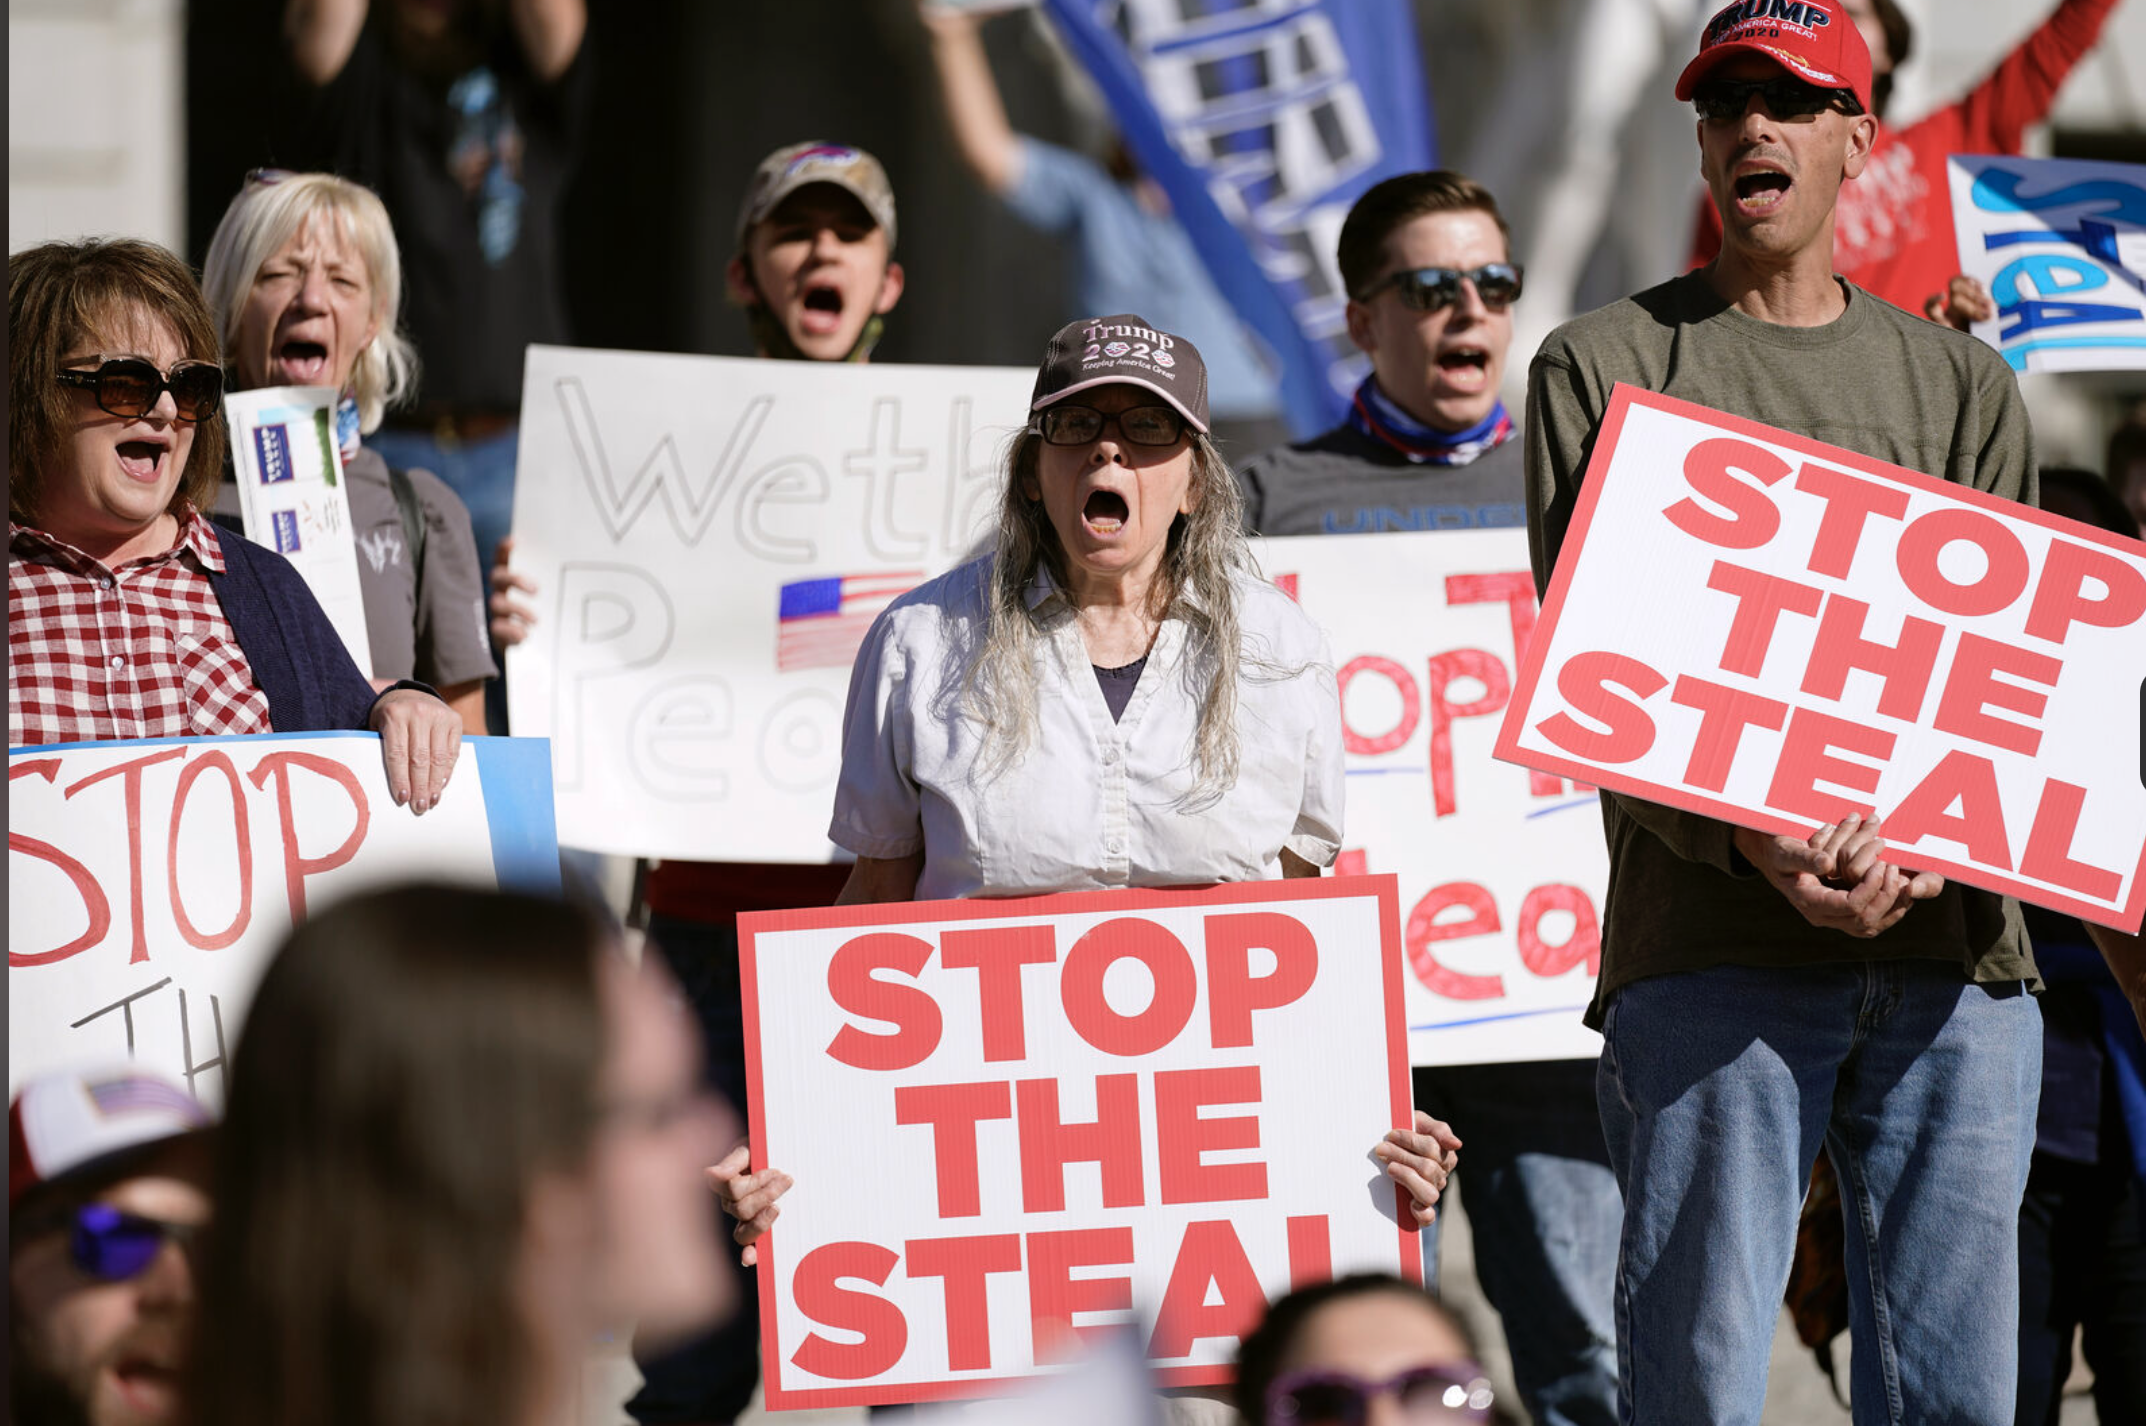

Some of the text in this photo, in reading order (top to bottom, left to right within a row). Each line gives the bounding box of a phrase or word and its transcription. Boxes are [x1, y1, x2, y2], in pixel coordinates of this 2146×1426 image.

[1708, 0, 1830, 39] TRUMP
[1732, 20, 1778, 34] AMERICA
[1780, 23, 1819, 42] GREAT!
[1734, 27, 1780, 42] 2020
[1082, 359, 1114, 371] Keeping
[1116, 358, 1151, 370] America
[1083, 319, 1175, 350] Trump
[842, 395, 1008, 562] th
[1323, 504, 1527, 534] UNDE
[1662, 437, 2146, 645] STOP
[553, 561, 845, 802] Peo
[1707, 559, 2064, 757] THE
[1535, 650, 2123, 903] STEAL
[9, 746, 371, 967] STOP
[70, 976, 232, 1102] TH
[825, 912, 1319, 1071] STOP
[894, 1065, 1269, 1219] THE
